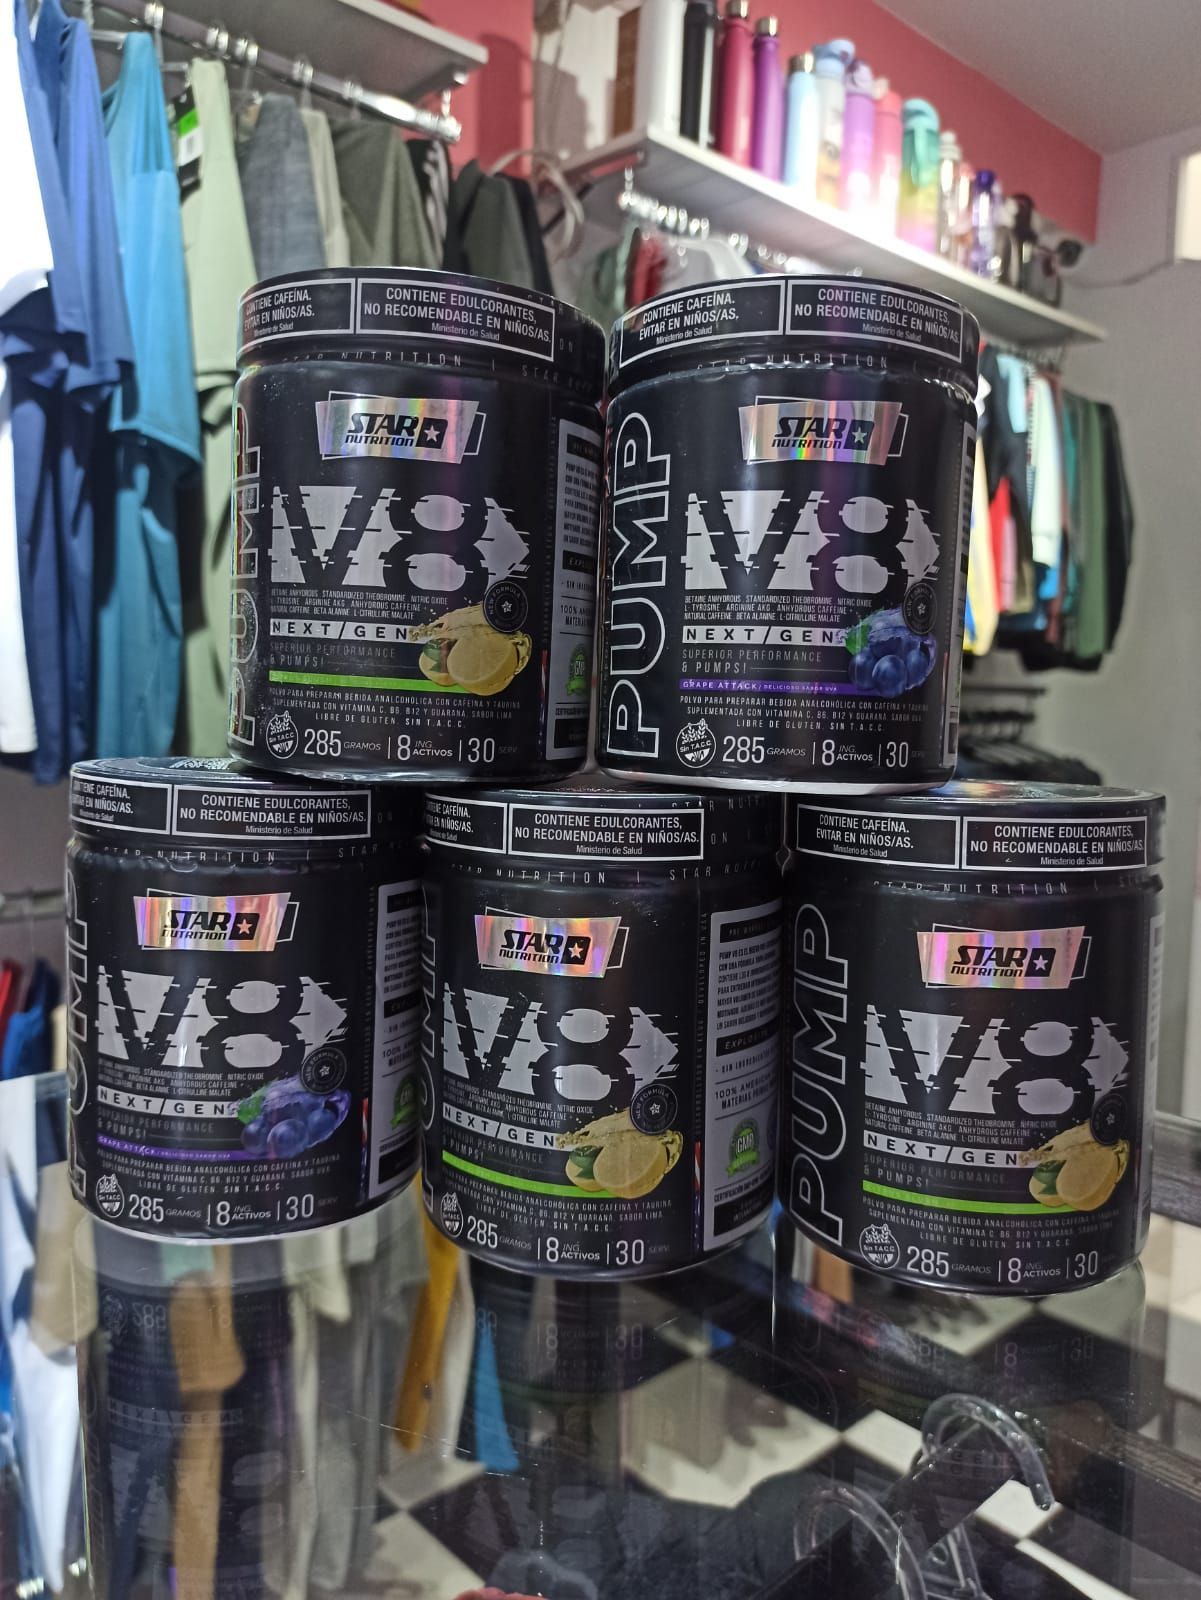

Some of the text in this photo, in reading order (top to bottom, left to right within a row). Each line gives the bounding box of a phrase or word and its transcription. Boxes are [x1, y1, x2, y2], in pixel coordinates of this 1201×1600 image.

[273, 288, 312, 305] CAFEÍNA.
[386, 287, 537, 325] CONTIENE EDULCORANTES,
[642, 292, 735, 326] CONTIENE CAFEÍNA.
[818, 288, 950, 325] CONTIENE EDULCORANTES,
[261, 312, 271, 325] EN
[271, 304, 316, 323] NIÑOS/AS.
[364, 303, 552, 344] NO RECOMENDABLE EN NIÑOS/AS.
[639, 306, 740, 342] EVITAR EN NIÑOS/AS.
[794, 303, 960, 344] NO RECOMENDABLE EN NIÑOS/AS.
[431, 322, 500, 342] Ministerio de Salud
[684, 328, 693, 339] de
[693, 325, 713, 337] Salud
[861, 322, 922, 342] Ministerio de Salud
[347, 413, 419, 437] STAR
[774, 417, 848, 438] STAR
[344, 434, 415, 448] NUTRITION
[771, 437, 842, 449] NUTRITION
[607, 412, 671, 758] PUMP
[681, 649, 823, 663] SUPERIOR PERFORMANCE
[696, 662, 746, 674] PUMPS!
[682, 681, 713, 689] GRAPE
[680, 695, 702, 704] POLVO
[704, 696, 723, 705] PARA
[726, 697, 766, 706] PREPARAR
[858, 701, 872, 710] CON
[687, 706, 803, 719] SUPLEMENTADA CON VITAMINA
[736, 719, 763, 728] LIBRE
[769, 720, 780, 729] DE
[829, 722, 845, 731] SIN
[303, 728, 496, 763] 285 GRAMOS 8 30
[412, 748, 453, 758] ACTIVOS
[722, 735, 909, 768] 285 GRAMOS 8 30
[836, 753, 873, 761] ACTIVOS
[96, 784, 131, 800] CAFEÍNA.
[85, 796, 94, 808] EN
[94, 798, 134, 814] NIÑOS/AS.
[201, 794, 351, 810] CONTIENE EDULCORANTES,
[180, 808, 367, 824] NO RECOMENDABLE EN NIÑOS/AS.
[442, 803, 471, 818] CAFEÍNA.
[440, 817, 474, 833] NIÑOS/AS.
[534, 812, 683, 831] CONTIENE EDULCORANTES,
[819, 814, 910, 833] CONTIENE CAFEÍNA.
[245, 825, 313, 835] Ministerio de Salud
[514, 827, 700, 844] NO RECOMENDABLE EN NIÑOS/AS.
[994, 825, 1134, 839] CONTIENE EDULCORANTES,
[816, 828, 914, 849] EVITAR EN NIÑOS/AS.
[970, 838, 1144, 854] NO RECOMENDABLE EN NIÑOS/AS.
[576, 844, 643, 855] Ministerio de Salud
[859, 848, 868, 856] de
[869, 847, 888, 858] Salud
[1040, 855, 1104, 866] Ministerio de Salud
[164, 909, 232, 931] STAR
[500, 929, 565, 954] STAR
[499, 948, 560, 964] NUTRITION
[951, 945, 1028, 968] STAR
[950, 965, 1024, 978] NUTRITION
[790, 903, 848, 1246] PUMP
[128, 1193, 315, 1227] 285 GRAMOS 8 30
[231, 1210, 272, 1220] ACTIVOS
[467, 1215, 498, 1249] 285
[545, 1236, 559, 1263] 8
[615, 1238, 645, 1266] 30
[560, 1251, 600, 1261] ACTIVOS
[906, 1245, 1099, 1284] 285 GRAMOS 8 30
[1022, 1268, 1062, 1278] ACTIVOS
